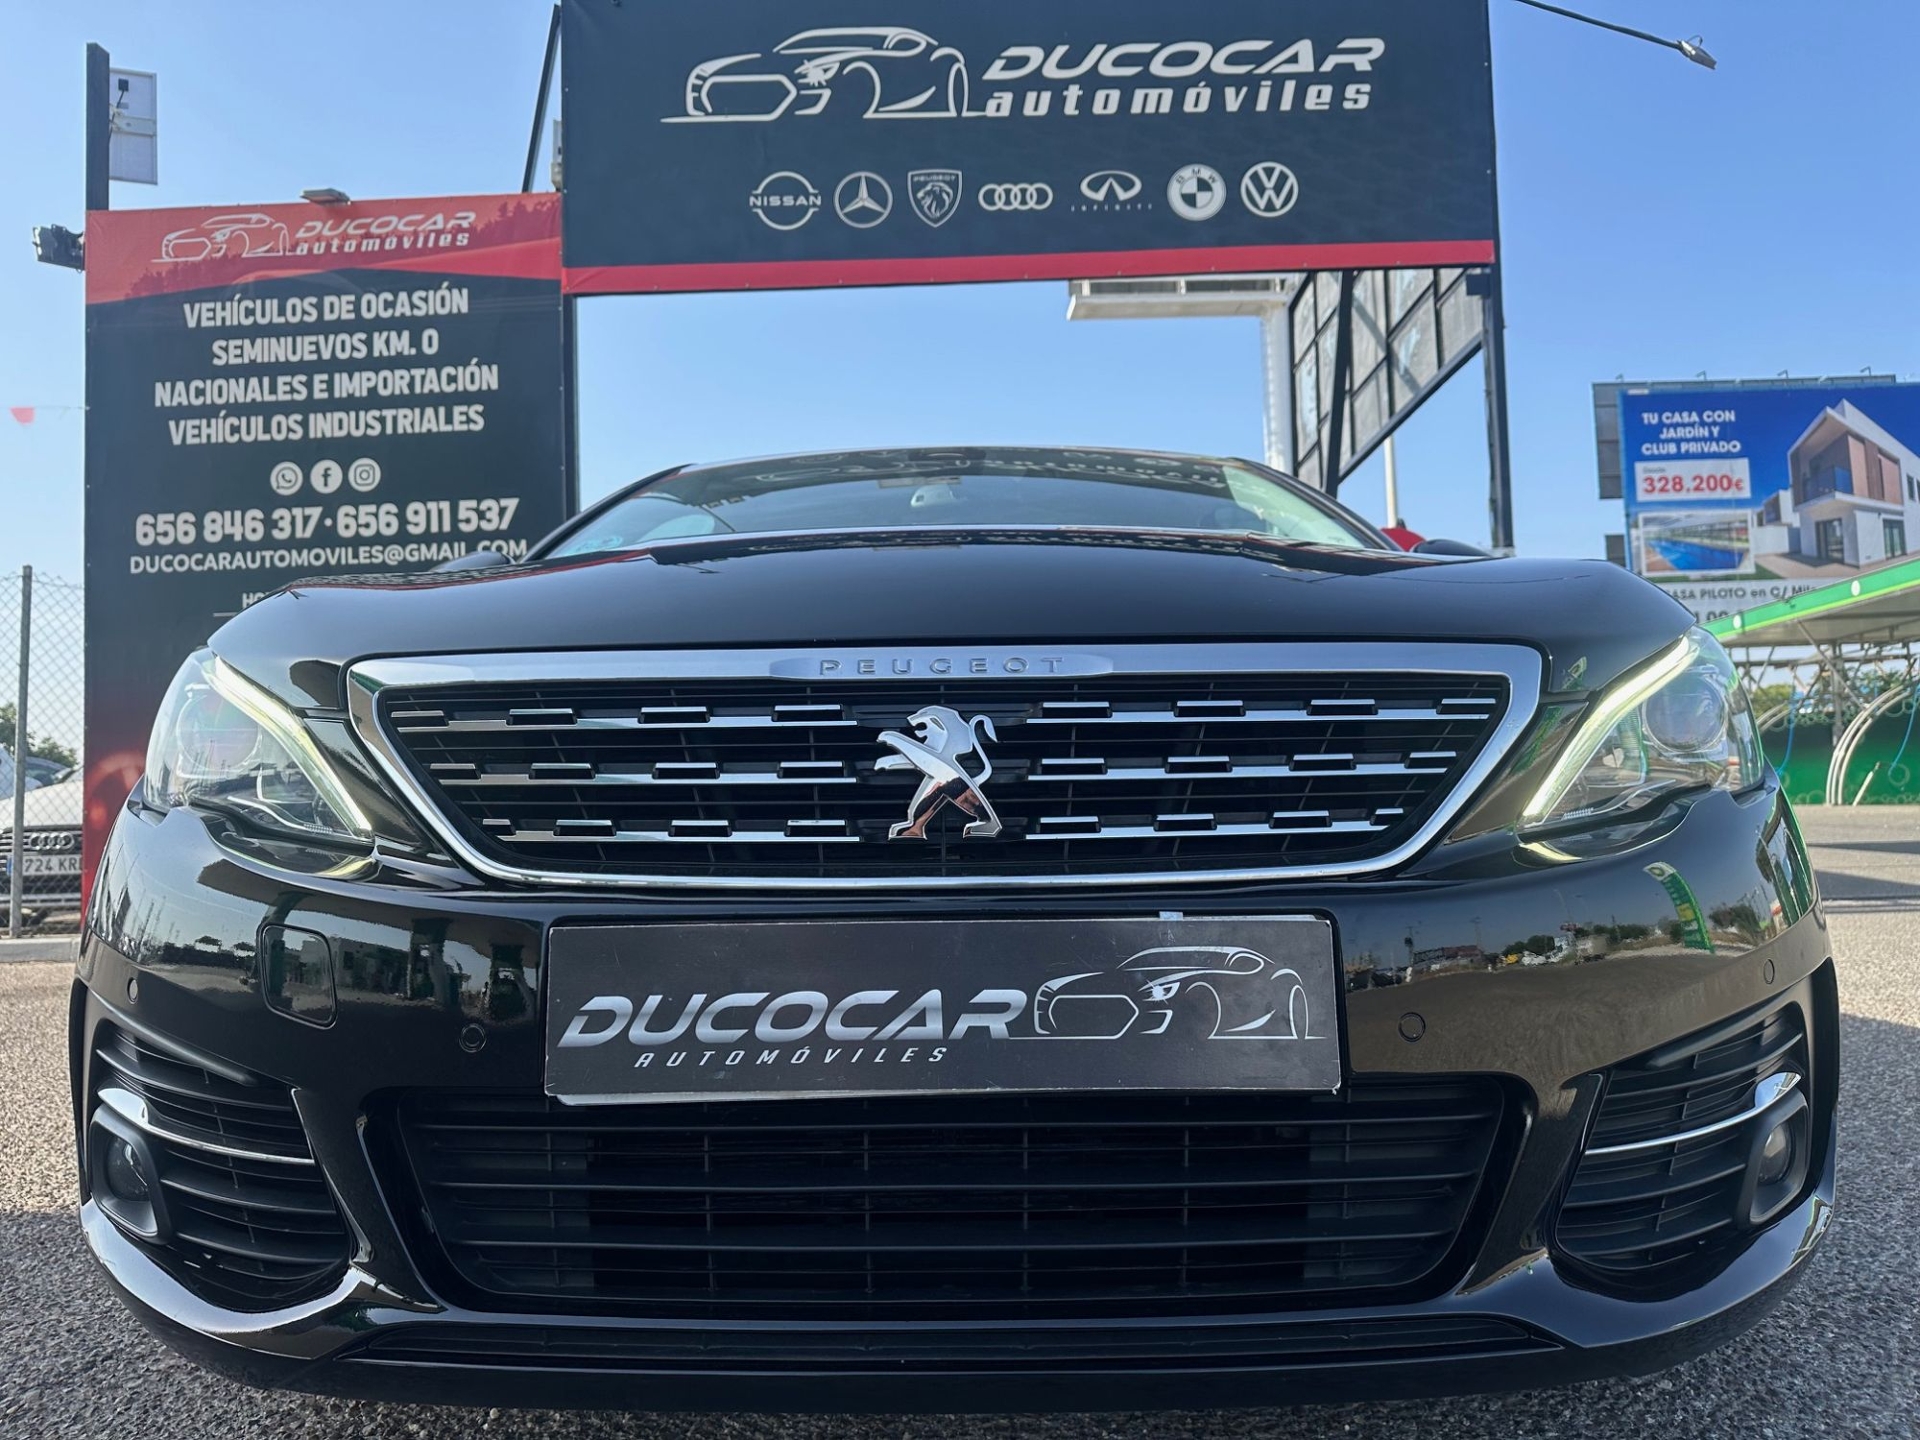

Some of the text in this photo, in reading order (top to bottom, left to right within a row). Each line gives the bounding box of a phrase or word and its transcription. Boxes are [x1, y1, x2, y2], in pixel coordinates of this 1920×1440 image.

[982, 38, 1385, 80] DUCOCAR
[986, 80, 1371, 117] automóviles
[913, 174, 956, 182] PEUGEOT
[750, 194, 821, 206] NISSAN
[295, 211, 476, 238] DUCOCAR
[296, 231, 470, 255] automóviles
[183, 281, 468, 328] VEHÍCULOS DE OCASIÓN
[212, 332, 368, 366] SEMINUEVOS
[373, 330, 416, 357] KM.
[154, 357, 499, 407] NACIONALES E IMPORTACIÓN
[168, 404, 485, 446] VEHÍCULOS INDUSTRIALES
[1642, 410, 1736, 424] TU CASA CON
[1659, 422, 1720, 439] JARDÍN Y
[1641, 440, 1742, 455] CLUB PRIVADO
[1643, 474, 1744, 494] 328.200€
[135, 512, 197, 546] 656
[202, 508, 265, 543] 846
[405, 500, 451, 535] 911
[457, 497, 520, 533] 537
[130, 539, 528, 574] DUCOCARAUTOMOVILES@GMAILCOM
[1669, 588, 1696, 599] ASA
[1700, 587, 1747, 599] PILOTO
[1751, 589, 1766, 598] en
[819, 657, 1063, 675] PEUGEOT
[24, 857, 82, 873] 724 KR
[557, 989, 1031, 1048] DUCOCAR
[633, 1046, 948, 1069] AUTOMÓVILES
